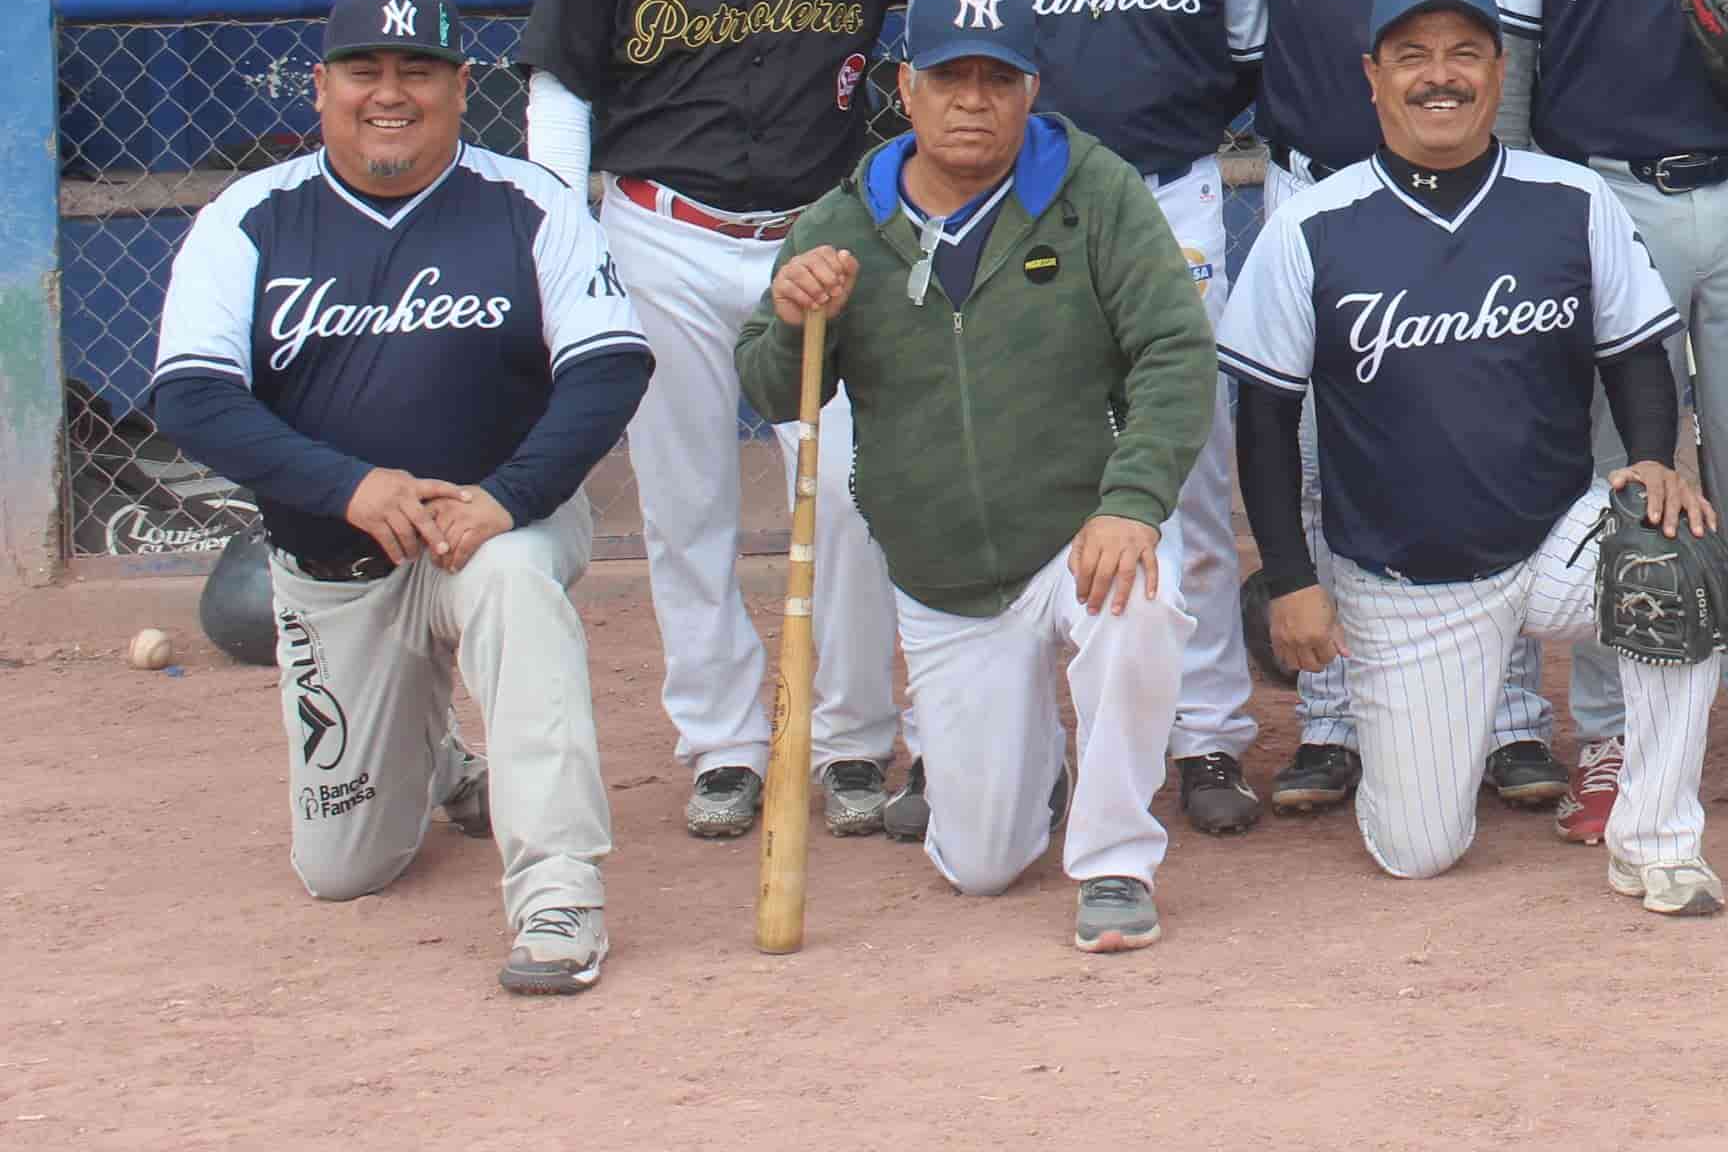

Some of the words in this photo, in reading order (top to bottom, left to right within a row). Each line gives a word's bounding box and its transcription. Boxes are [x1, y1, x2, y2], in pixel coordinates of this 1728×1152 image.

[381, 0, 417, 37] NY
[265, 266, 512, 370] Yankees
[1335, 274, 1580, 383] Yankees
[319, 773, 369, 802] Banco
[321, 785, 376, 819] Famsa
